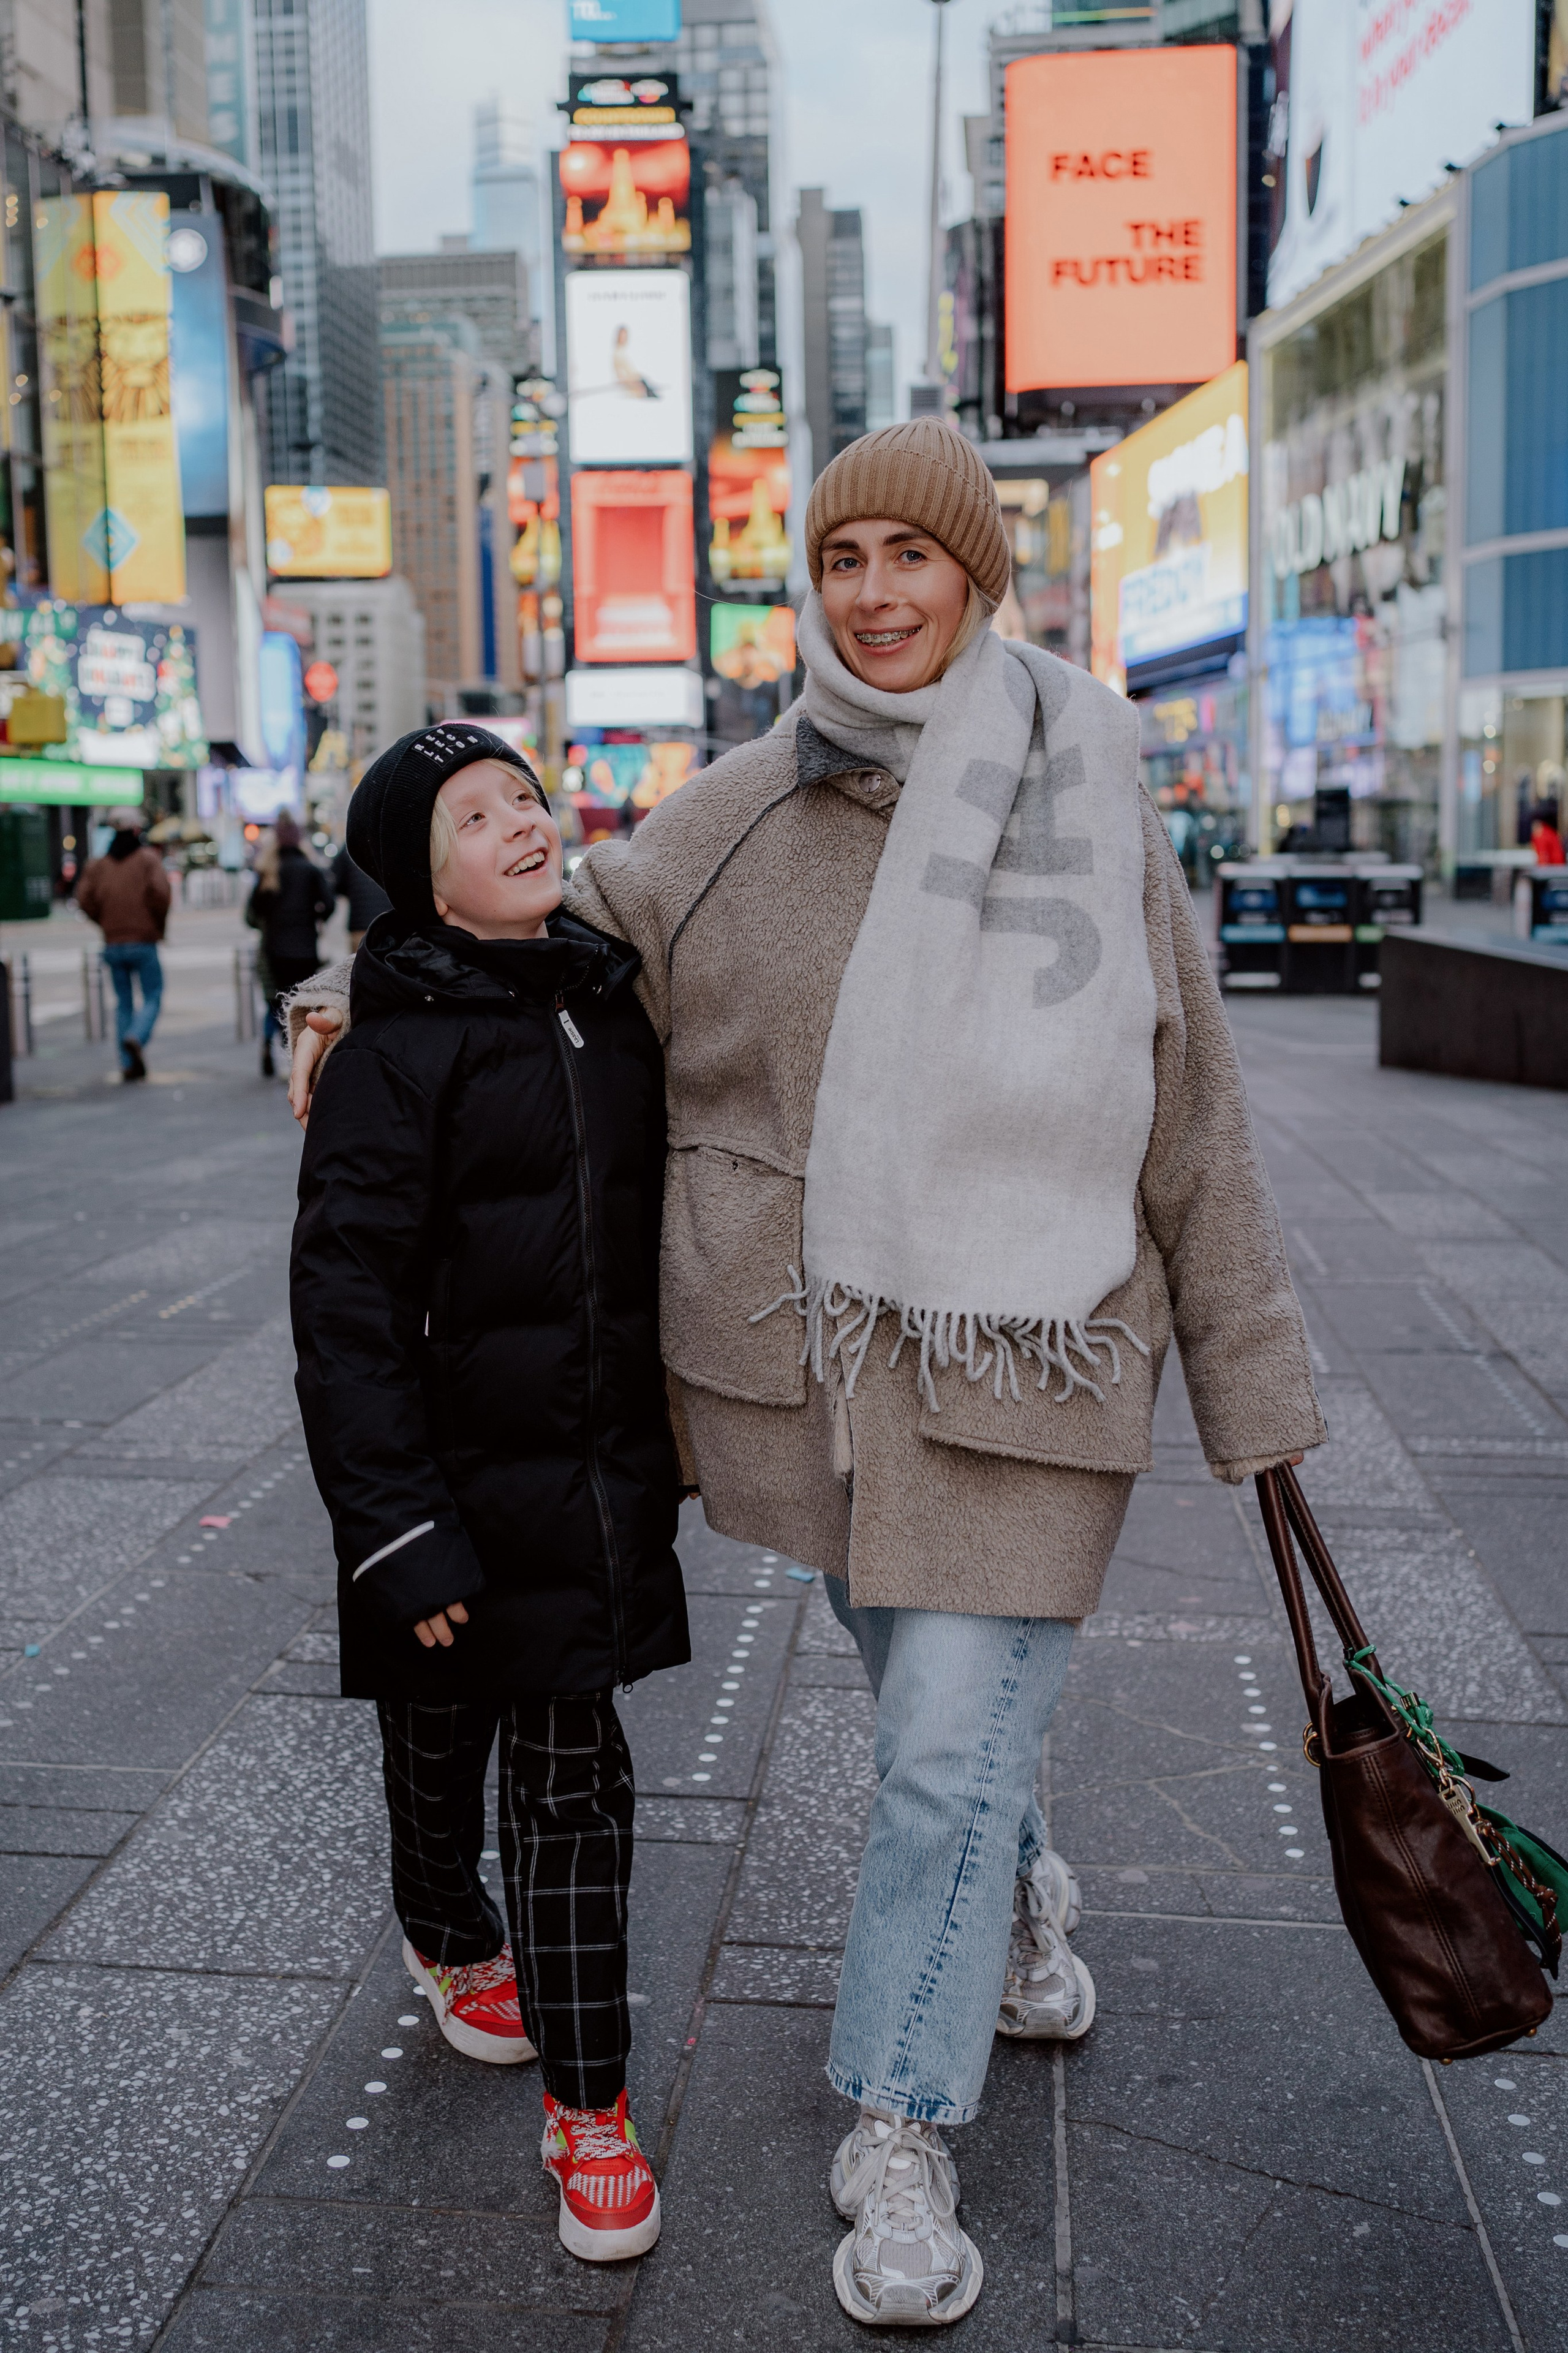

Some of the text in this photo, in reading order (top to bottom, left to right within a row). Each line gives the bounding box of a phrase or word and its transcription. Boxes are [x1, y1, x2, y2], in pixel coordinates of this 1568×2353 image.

[1051, 151, 1149, 180] FACE
[1128, 219, 1202, 249] THE
[1051, 254, 1202, 287] FUTURE
[424, 735, 456, 757] LEC
[434, 735, 478, 763] TION
